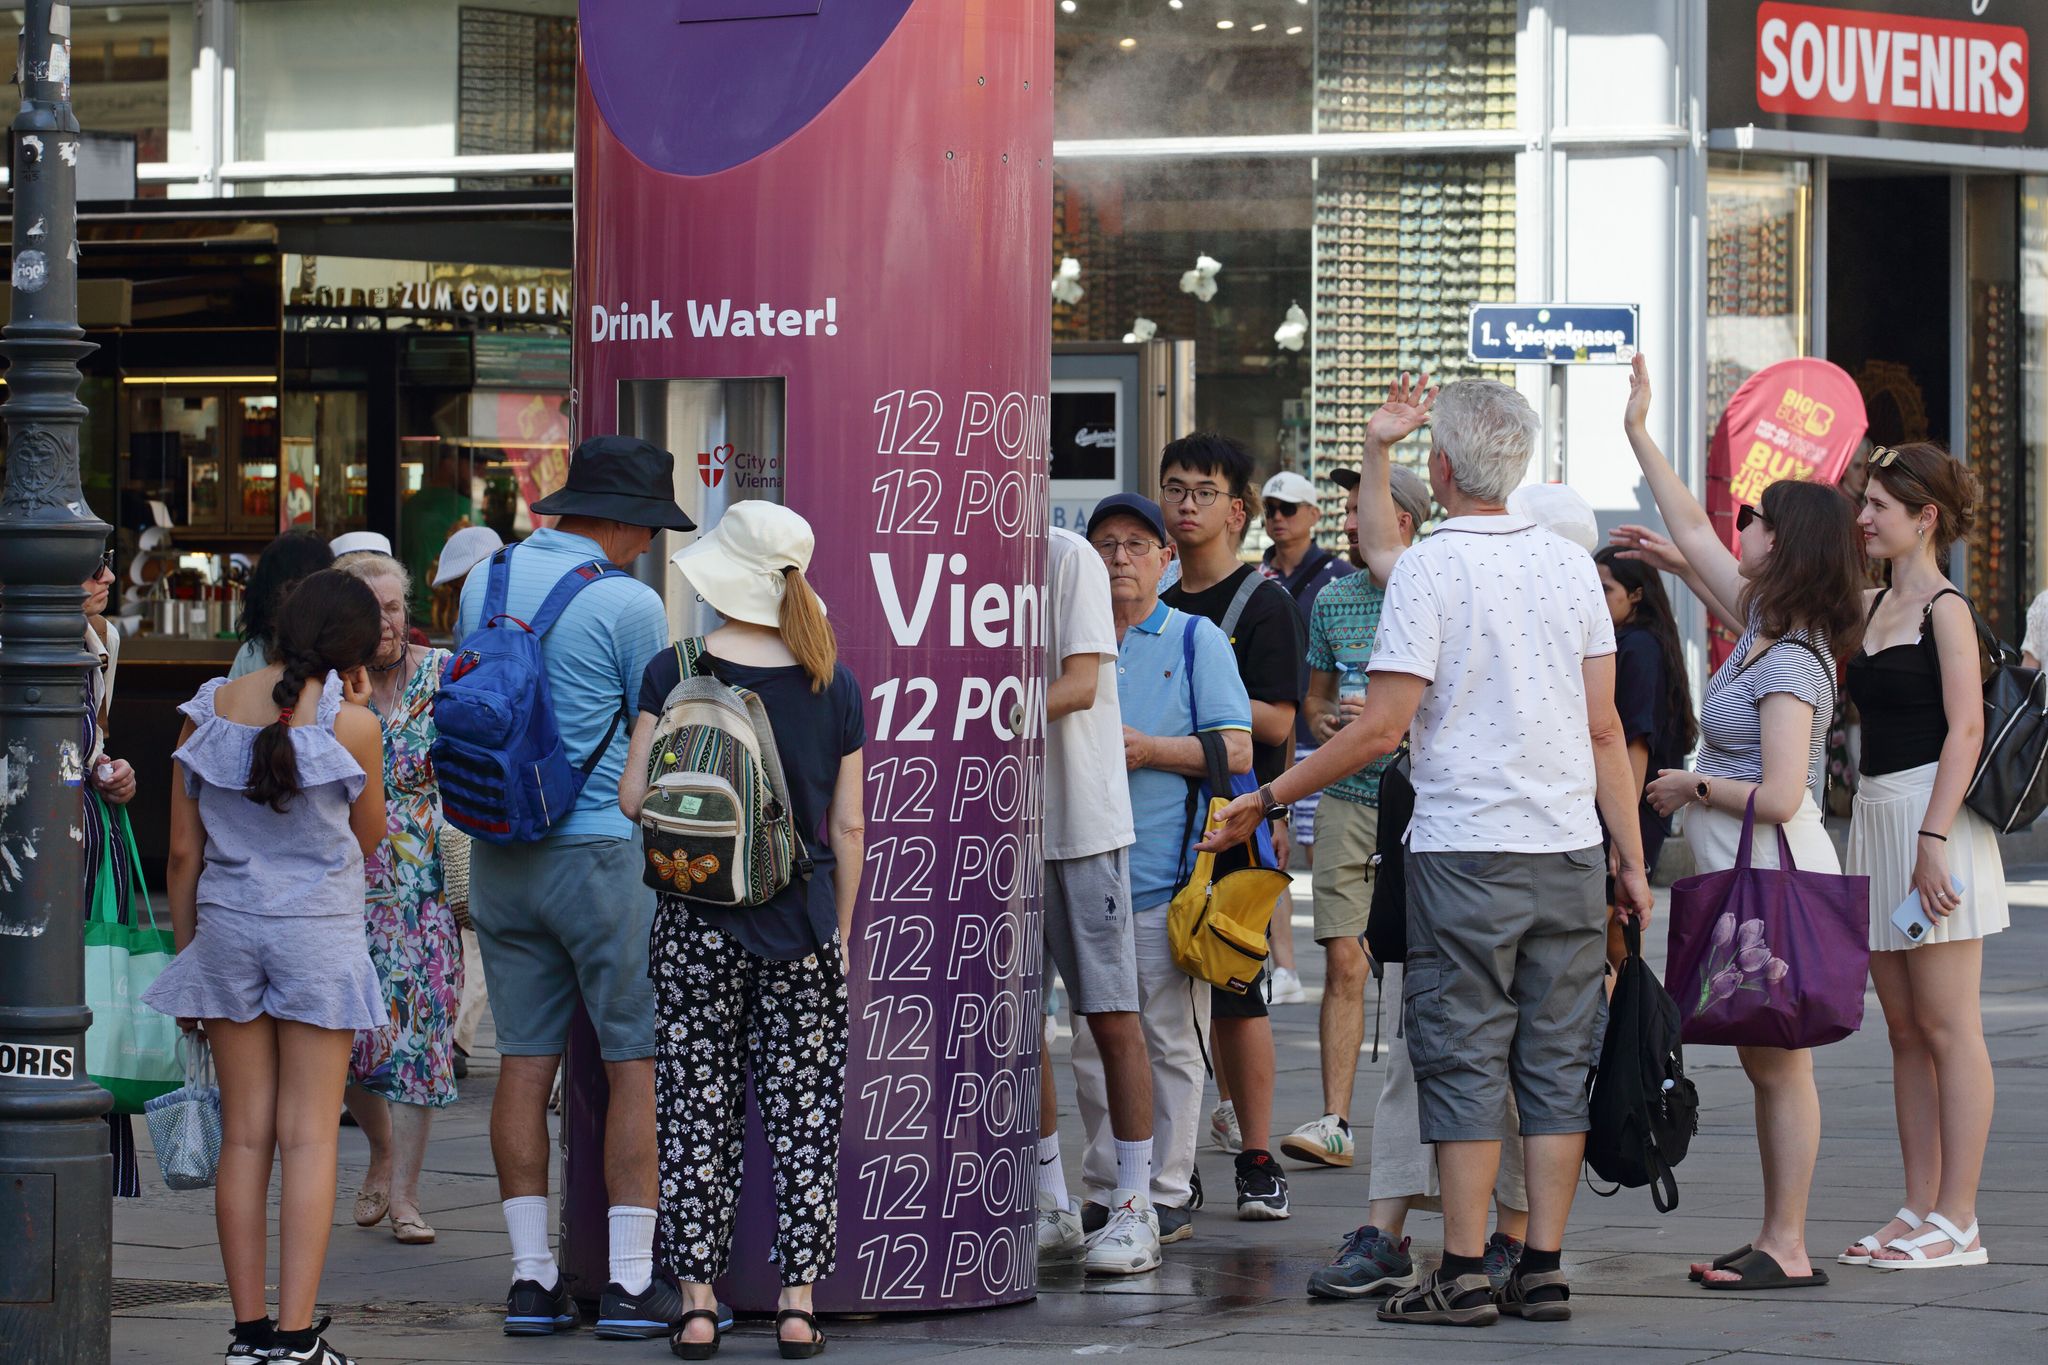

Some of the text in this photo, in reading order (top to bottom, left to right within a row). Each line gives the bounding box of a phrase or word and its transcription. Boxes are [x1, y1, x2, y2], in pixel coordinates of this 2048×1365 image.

[1760, 17, 2025, 117] SOUVENIRS
[401, 282, 451, 312] ZUM
[461, 284, 569, 316] GOLDEN
[591, 297, 838, 342] Drink Water!
[1505, 321, 1626, 352] Spiegelgasse
[872, 390, 943, 457] 12
[1776, 403, 1806, 425] BUS
[1781, 388, 1813, 414] BIG
[734, 453, 766, 474] City
[734, 471, 783, 488] Vienna
[1745, 441, 1813, 481] BUY
[871, 469, 942, 535] 12
[870, 677, 938, 742] 12
[867, 756, 937, 823] 12
[865, 835, 936, 901] 12
[863, 914, 934, 981] 12
[861, 994, 933, 1061] 12
[860, 1073, 931, 1140] 12
[858, 1153, 930, 1220] 12
[857, 1233, 928, 1300] 12
[232, 1344, 250, 1353] NIKE
